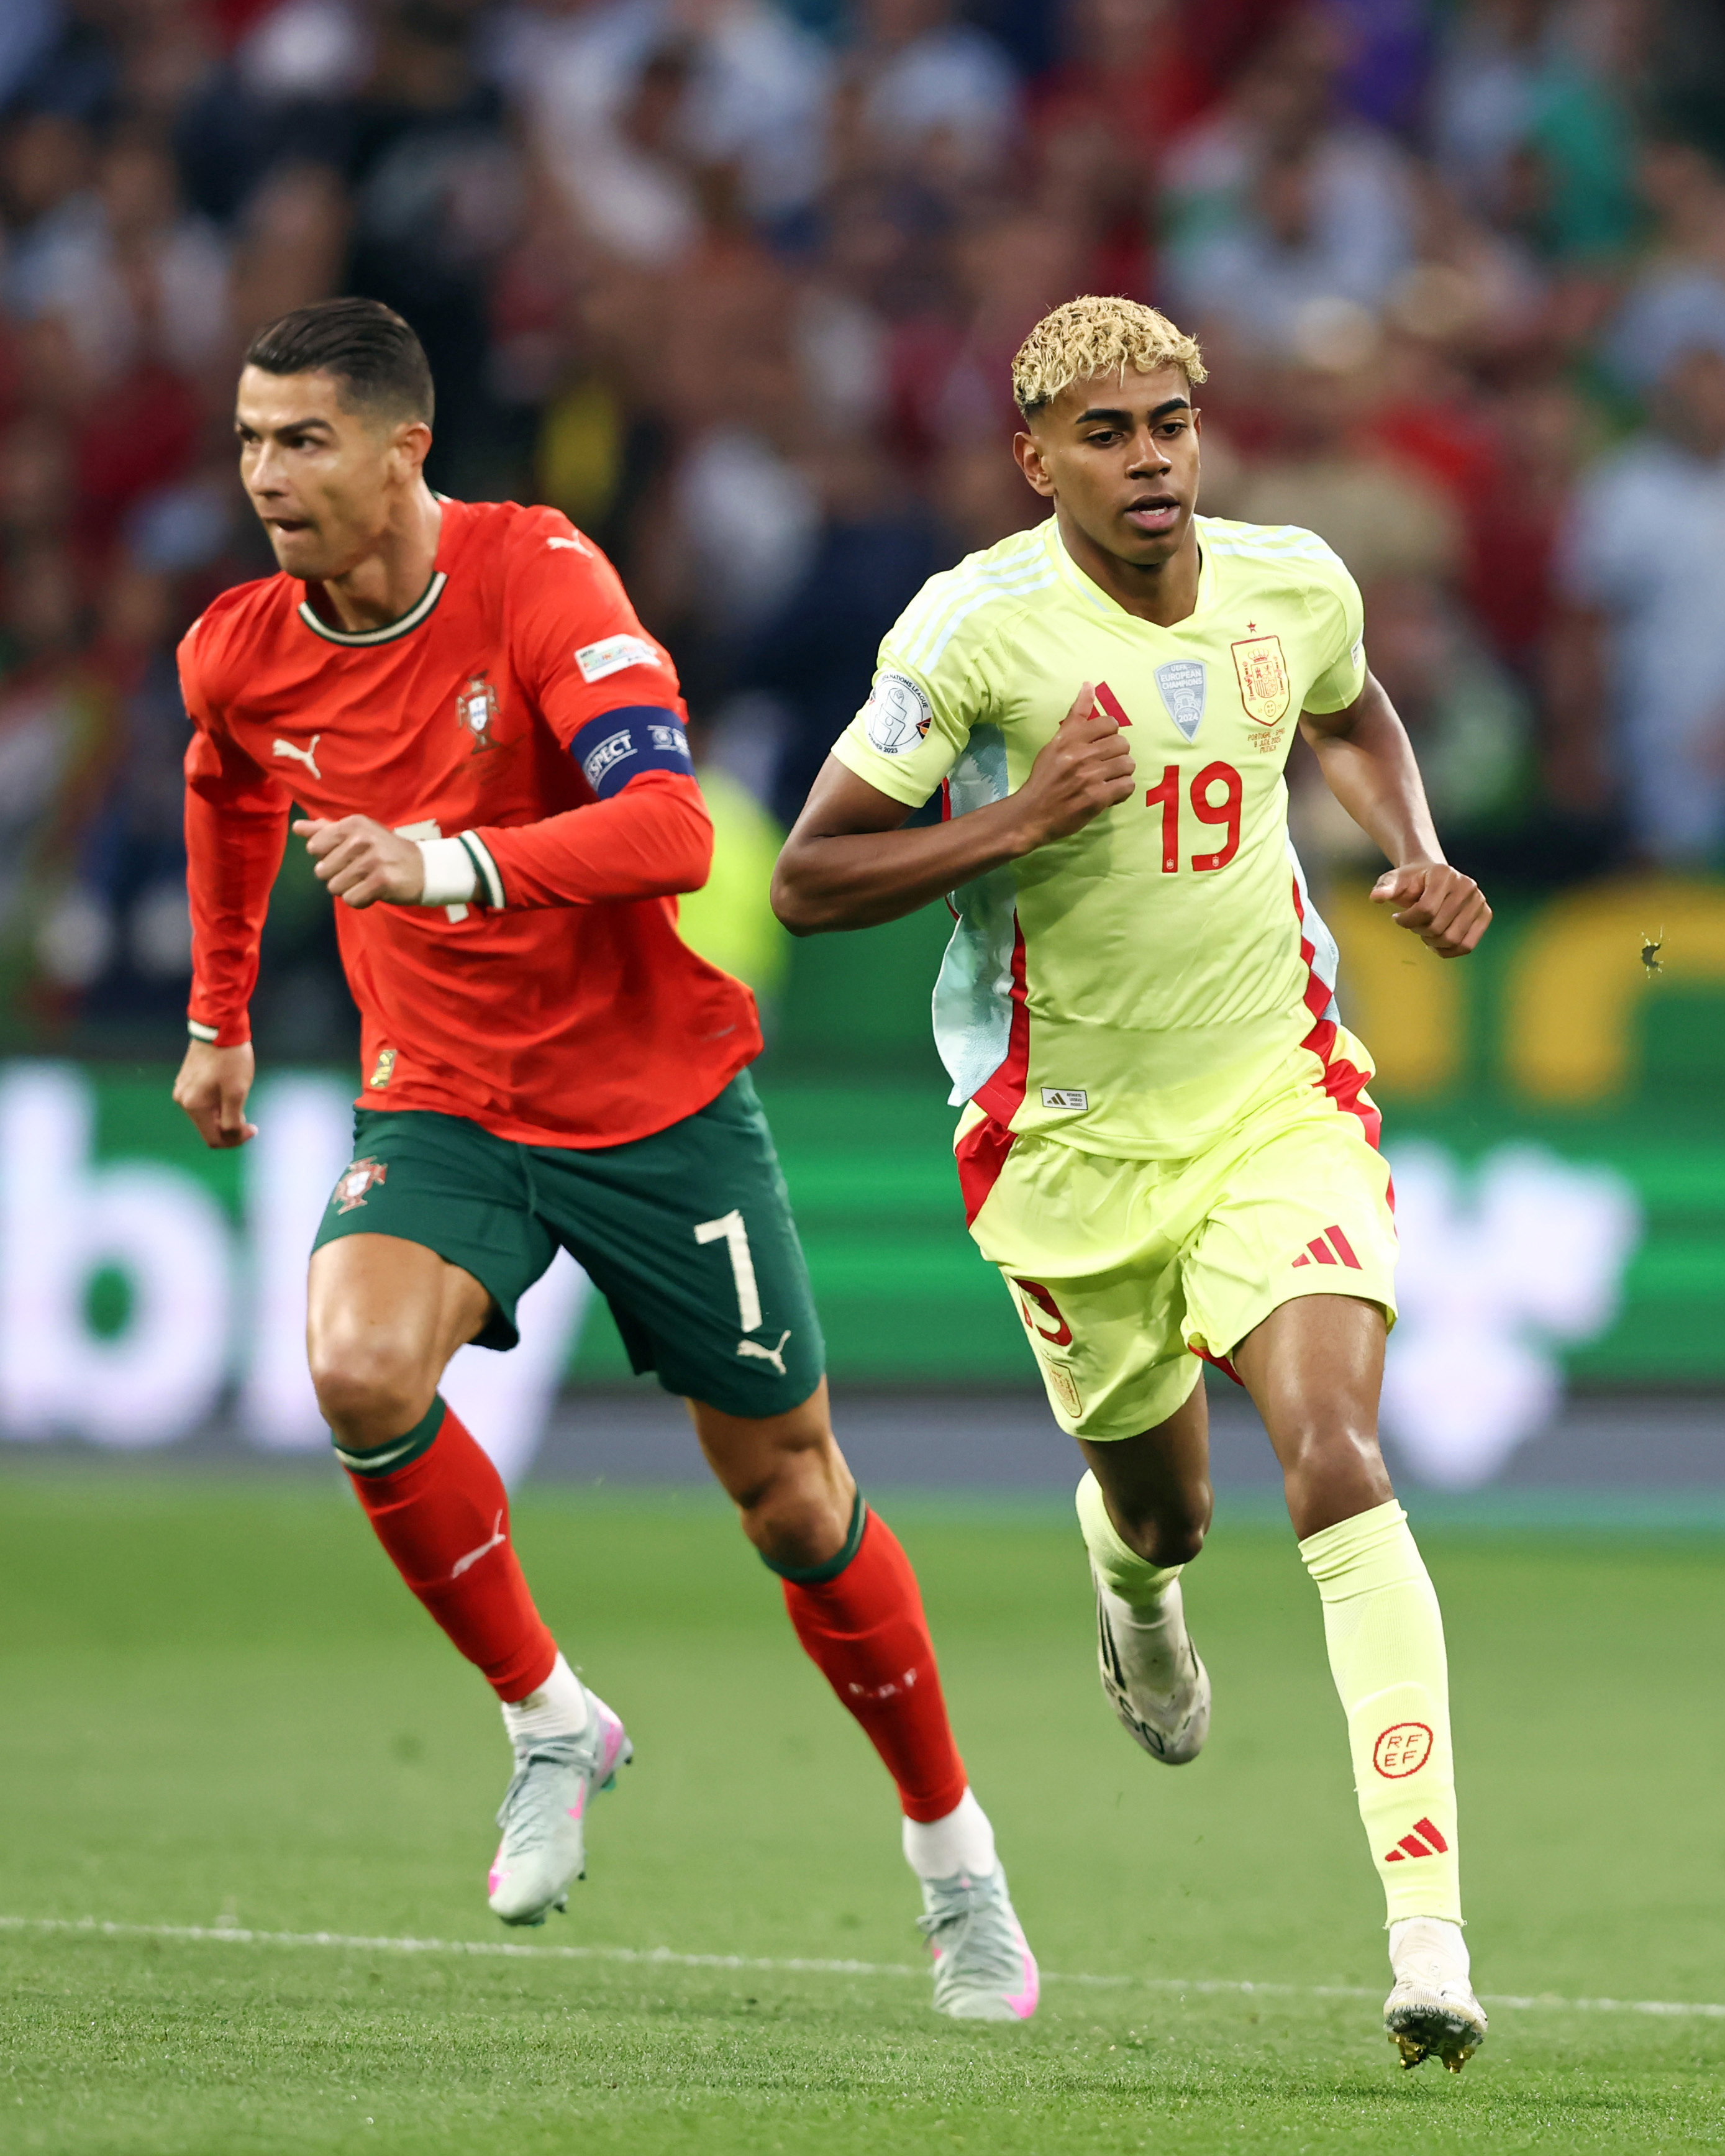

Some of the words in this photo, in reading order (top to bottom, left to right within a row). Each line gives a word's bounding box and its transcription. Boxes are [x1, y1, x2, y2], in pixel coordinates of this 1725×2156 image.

[1160, 669, 1202, 682] EUROPEAN
[1162, 678, 1203, 690] CHAMPIONS
[890, 674, 913, 688] NATIONS
[911, 686, 929, 709] LEAGUE
[1178, 712, 1198, 723] 2024
[1248, 732, 1271, 741] PORTUGAL
[1146, 761, 1242, 873] 19
[694, 1208, 763, 1333] 7
